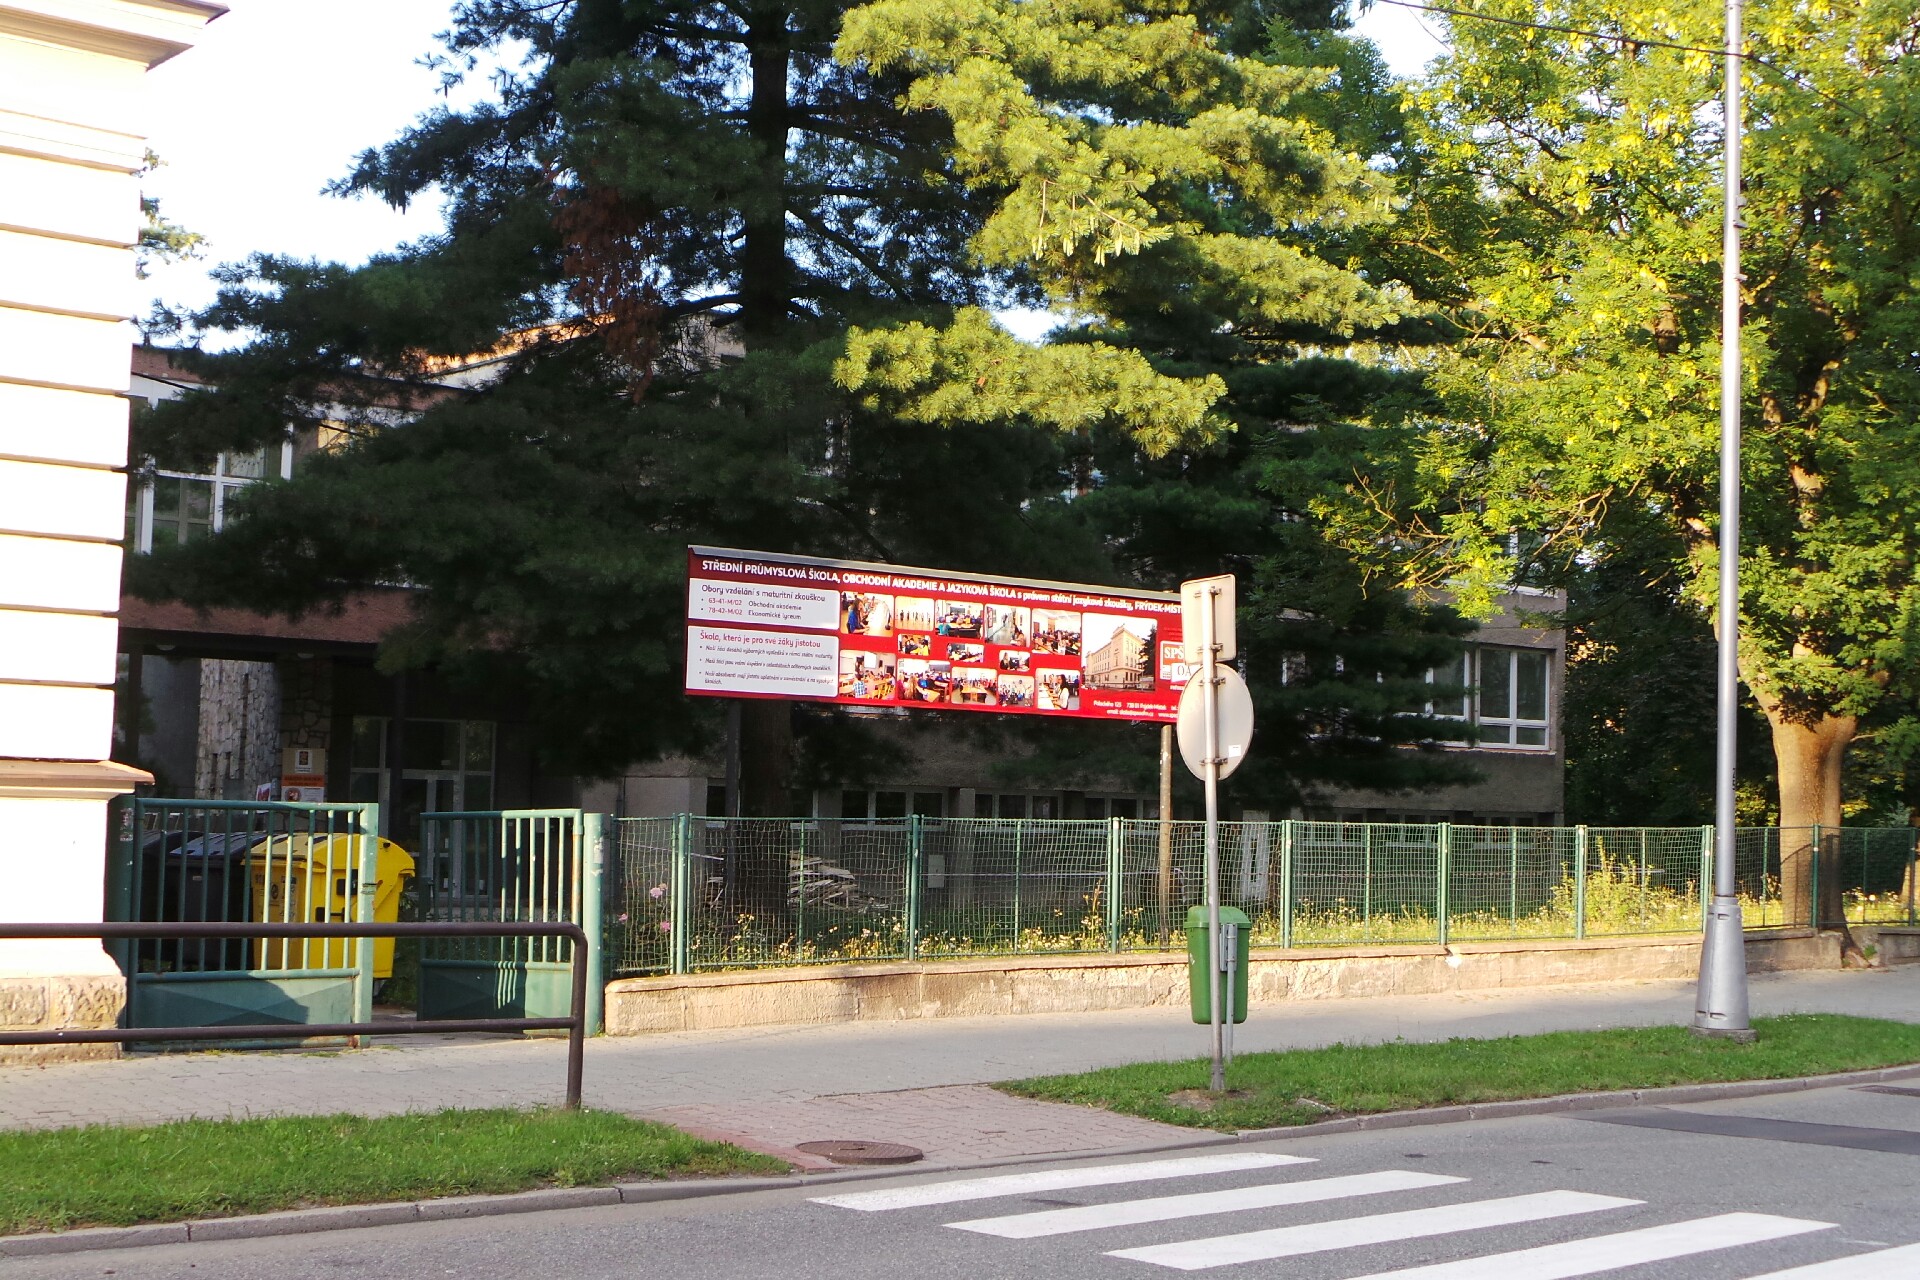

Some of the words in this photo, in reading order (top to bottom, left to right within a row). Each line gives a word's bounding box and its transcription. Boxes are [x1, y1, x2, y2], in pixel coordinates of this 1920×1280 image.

[702, 559, 742, 573] STŘEDNÍ
[745, 563, 806, 579] PRŮMYSLOVÁ
[808, 567, 840, 583] ŠKOLA,
[843, 573, 890, 587] OBCHODNÍ
[892, 578, 938, 591] AKADEMIE
[938, 582, 945, 592] A
[946, 582, 988, 596] JAZYKOVÁ
[990, 584, 1016, 598] ŠKOLA
[1023, 590, 1050, 602] právem
[1051, 593, 1072, 604] státní
[1073, 594, 1103, 608] jazykové
[1104, 596, 1133, 610] zkoušky,
[1135, 600, 1182, 614] FRÝDEK-MÍST
[702, 584, 724, 594] Obory
[726, 587, 755, 596] vzdělání
[762, 590, 794, 599] maturitní
[794, 593, 826, 602] zkouškou
[748, 600, 775, 608] Obchodní
[700, 632, 721, 642] Škola,
[723, 634, 741, 642] která
[743, 636, 750, 644] je
[752, 638, 764, 646] pro
[777, 638, 794, 648] žáky
[795, 640, 821, 648] jistotou
[1164, 645, 1184, 660] SPŠ
[1178, 664, 1192, 676] OA
